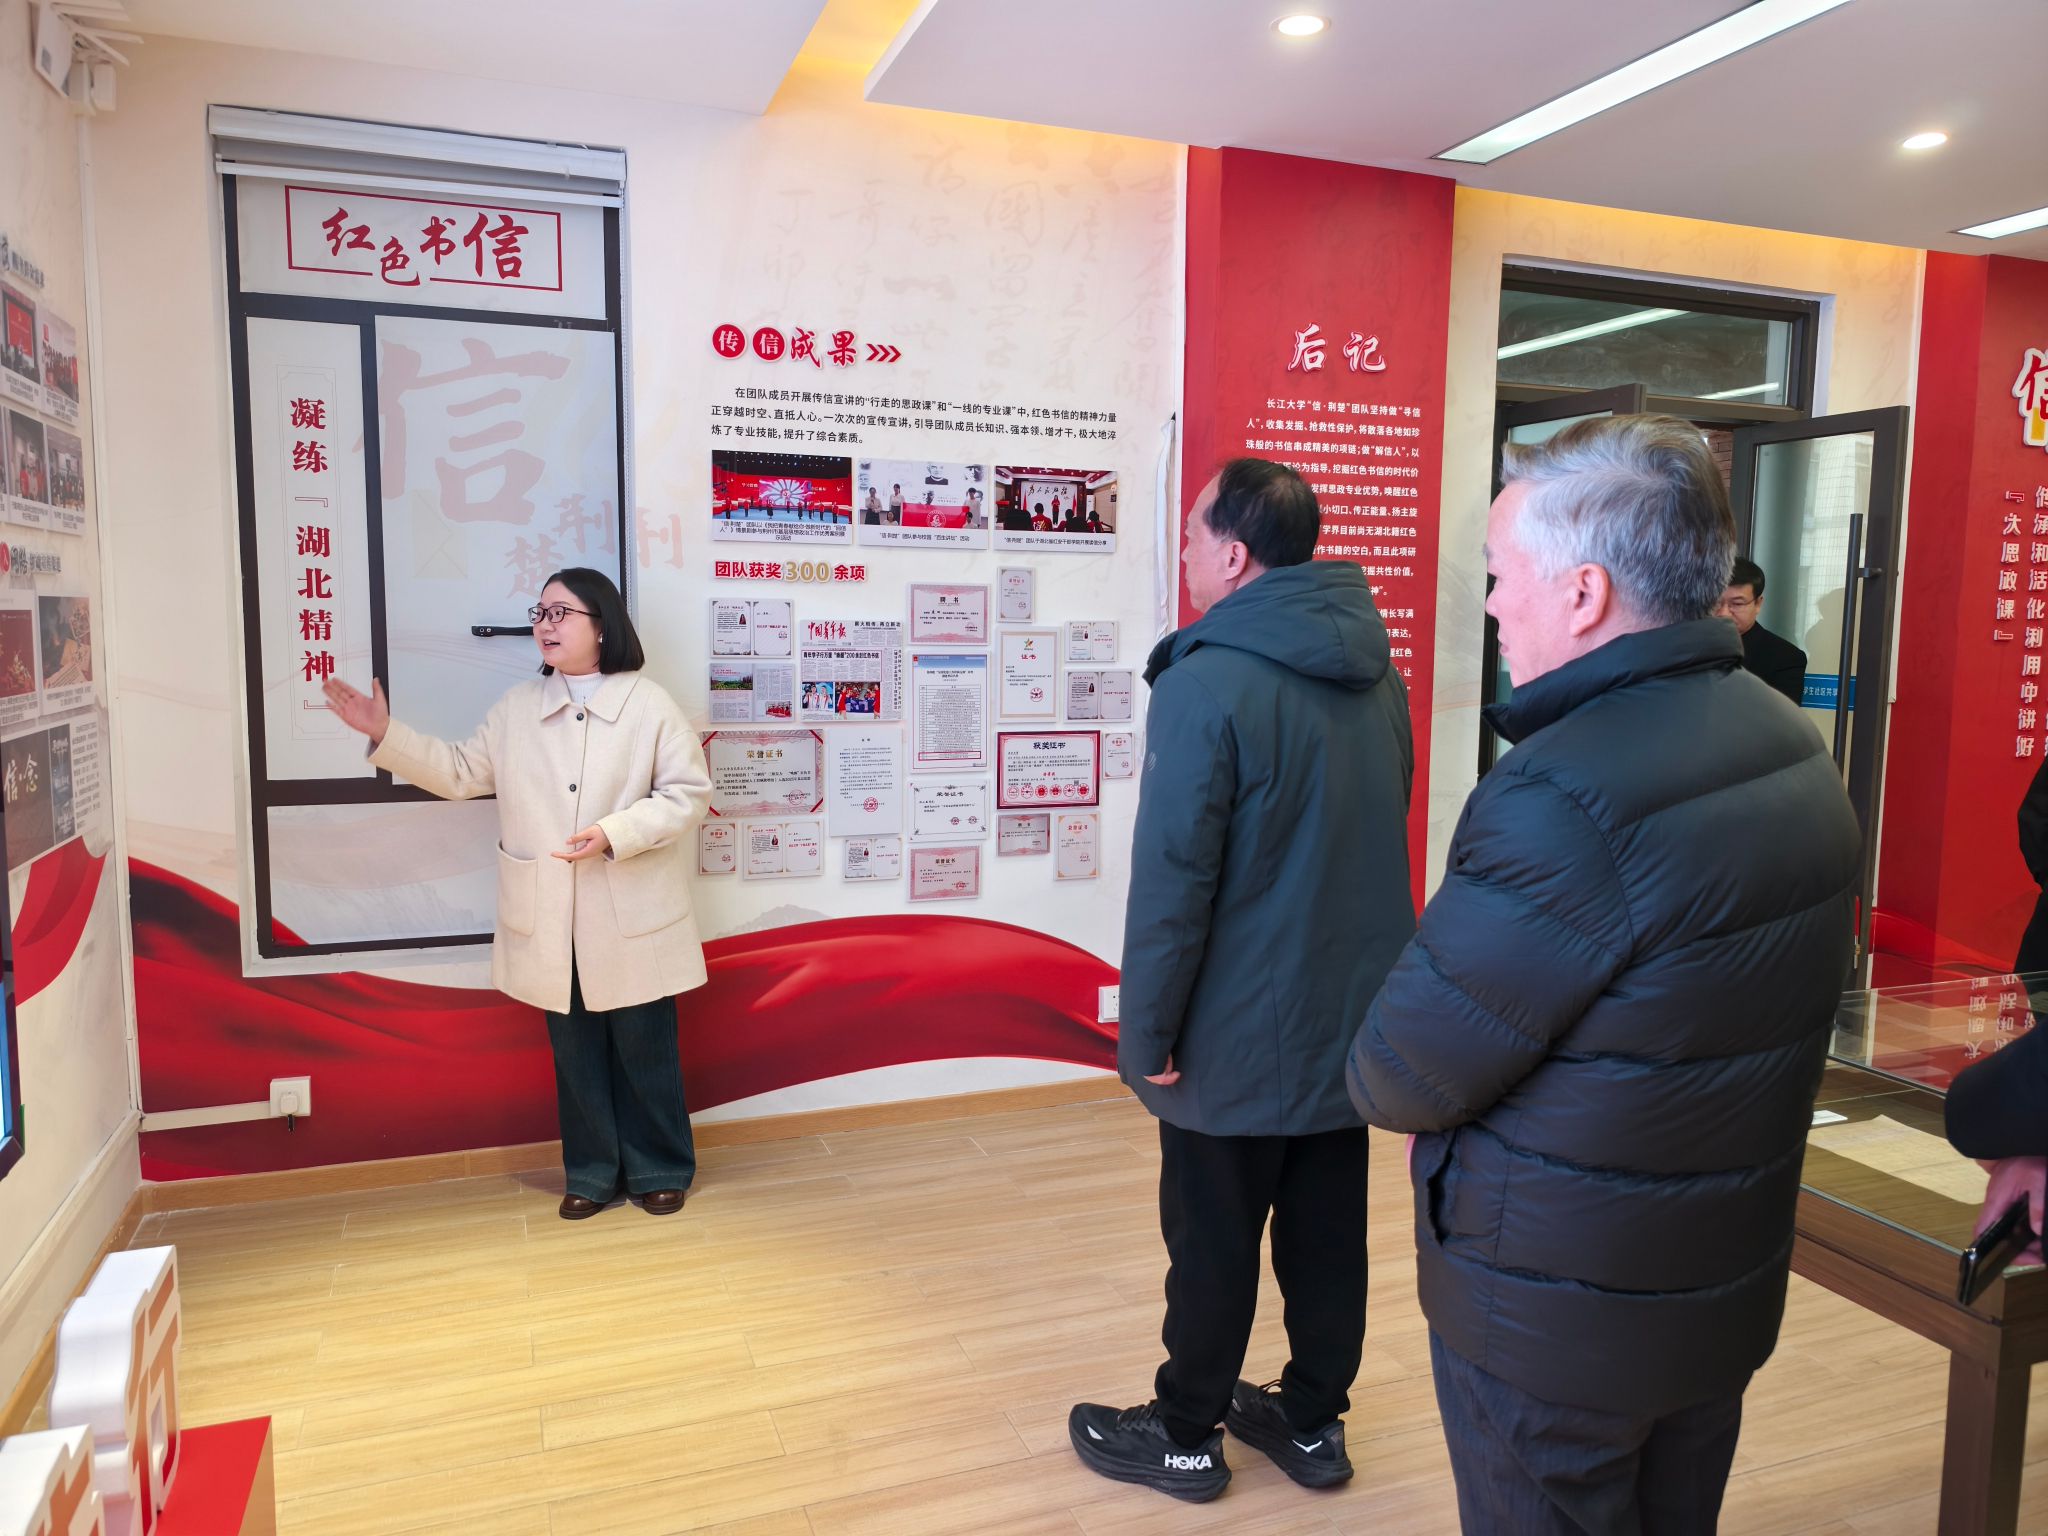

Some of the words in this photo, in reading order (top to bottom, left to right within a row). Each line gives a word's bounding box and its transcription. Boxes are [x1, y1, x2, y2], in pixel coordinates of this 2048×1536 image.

[322, 207, 529, 286] 红色书信
[717, 326, 858, 368] 传信成果
[1288, 323, 1387, 373] 后记
[1319, 505, 1418, 518] 小切口、传正能量、扬主旋
[1320, 525, 1417, 537] 学界目前尚无湖北籍红色
[1164, 1453, 1212, 1470] HOKA
